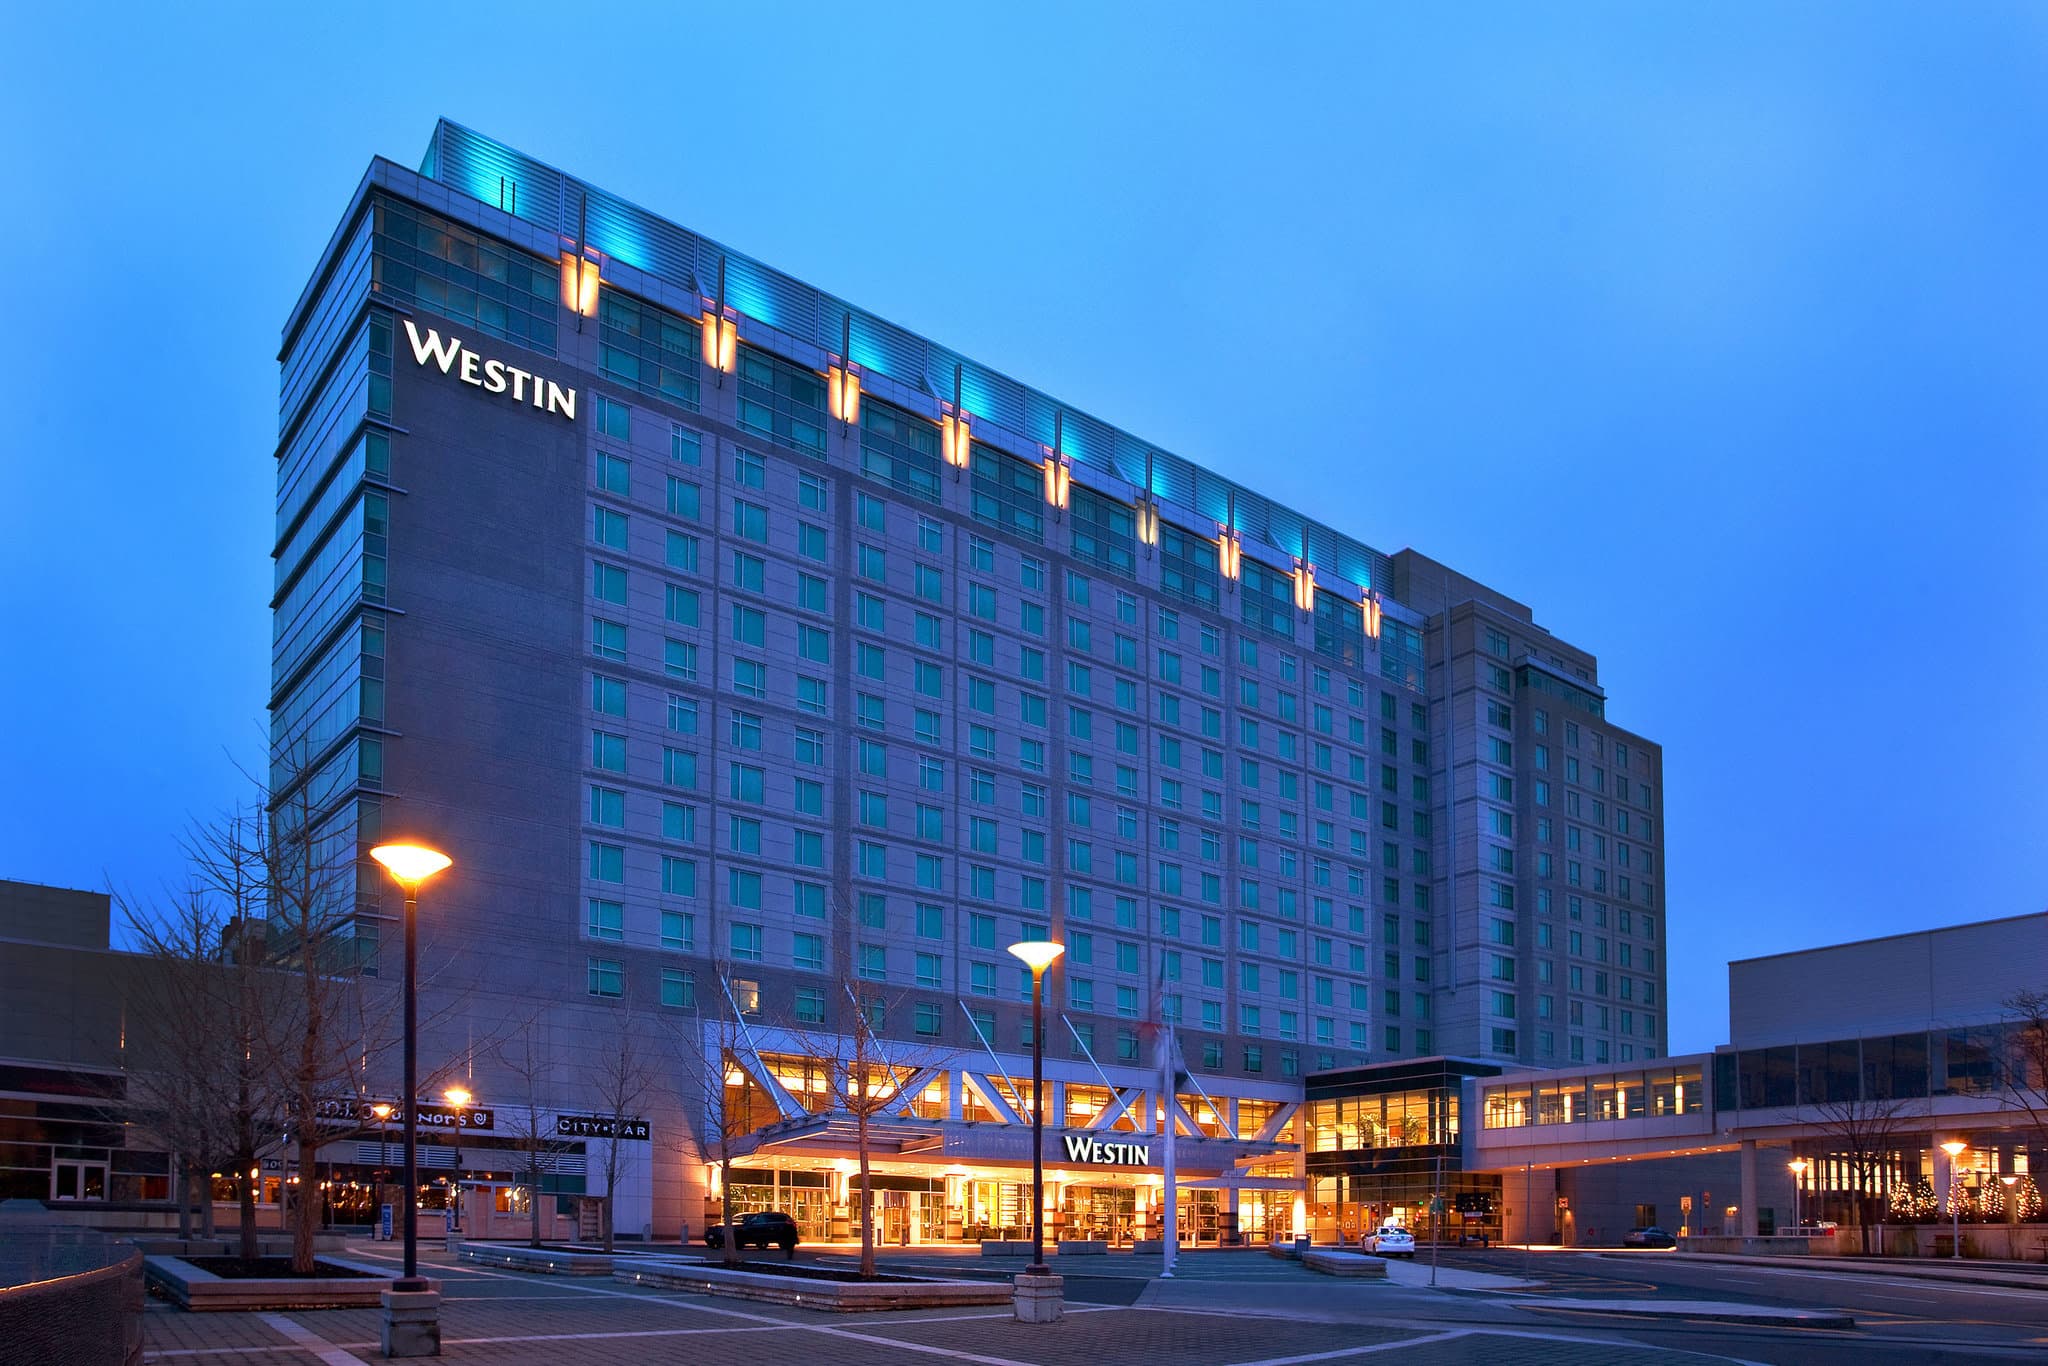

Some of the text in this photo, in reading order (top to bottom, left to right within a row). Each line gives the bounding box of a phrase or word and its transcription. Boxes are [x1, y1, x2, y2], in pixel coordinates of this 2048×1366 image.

[403, 319, 576, 420] WESTIN
[559, 1120, 601, 1133] CITY
[1065, 1136, 1149, 1165] WESTIN
